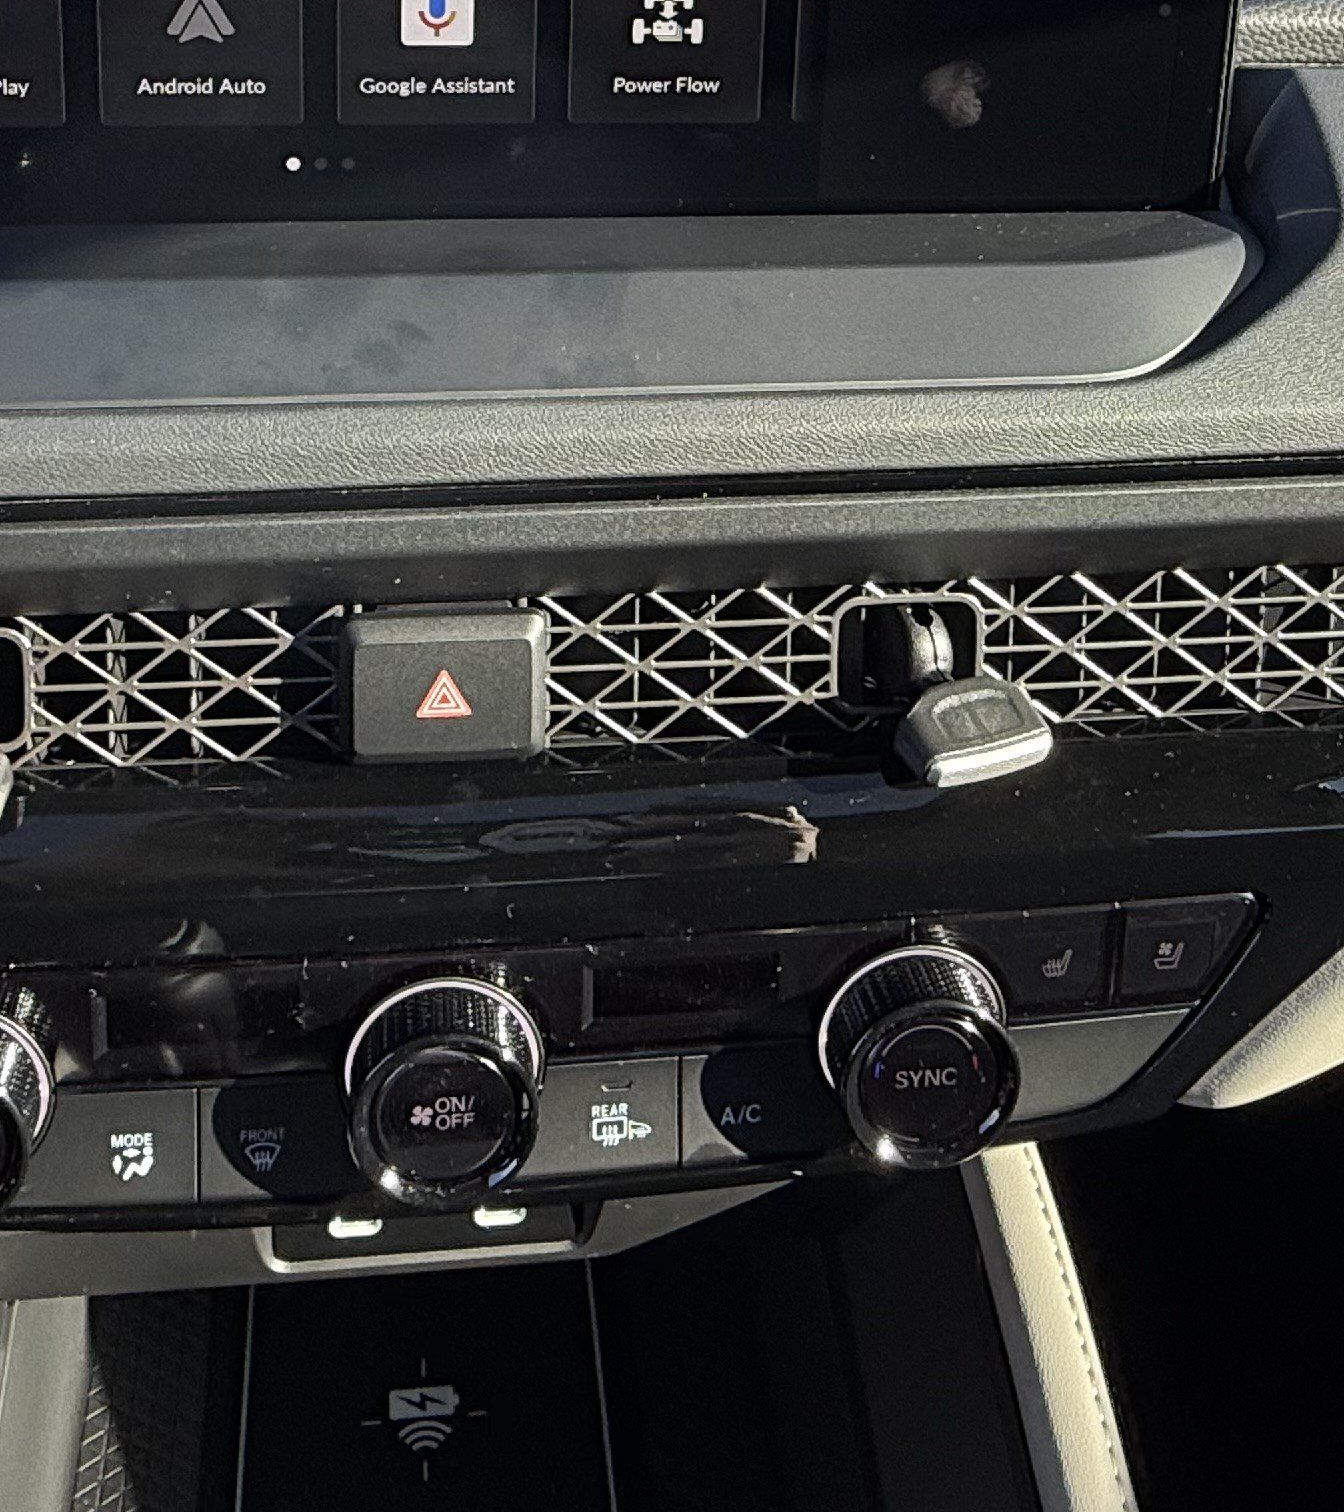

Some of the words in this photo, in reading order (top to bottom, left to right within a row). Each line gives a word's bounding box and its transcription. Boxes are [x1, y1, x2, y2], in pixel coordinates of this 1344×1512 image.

[137, 76, 213, 96] Android
[218, 76, 266, 96] Auto
[359, 76, 426, 100] Google
[431, 75, 516, 96] Assistant
[613, 76, 671, 96] Power
[676, 75, 720, 96] Flow
[895, 1066, 958, 1091] SYNC
[435, 1096, 476, 1114] ON/
[591, 1104, 629, 1118] REAR
[435, 1111, 478, 1131] OFF
[720, 1106, 762, 1126] A/C
[111, 1134, 154, 1148] MODE
[240, 1128, 286, 1144] FRONT
